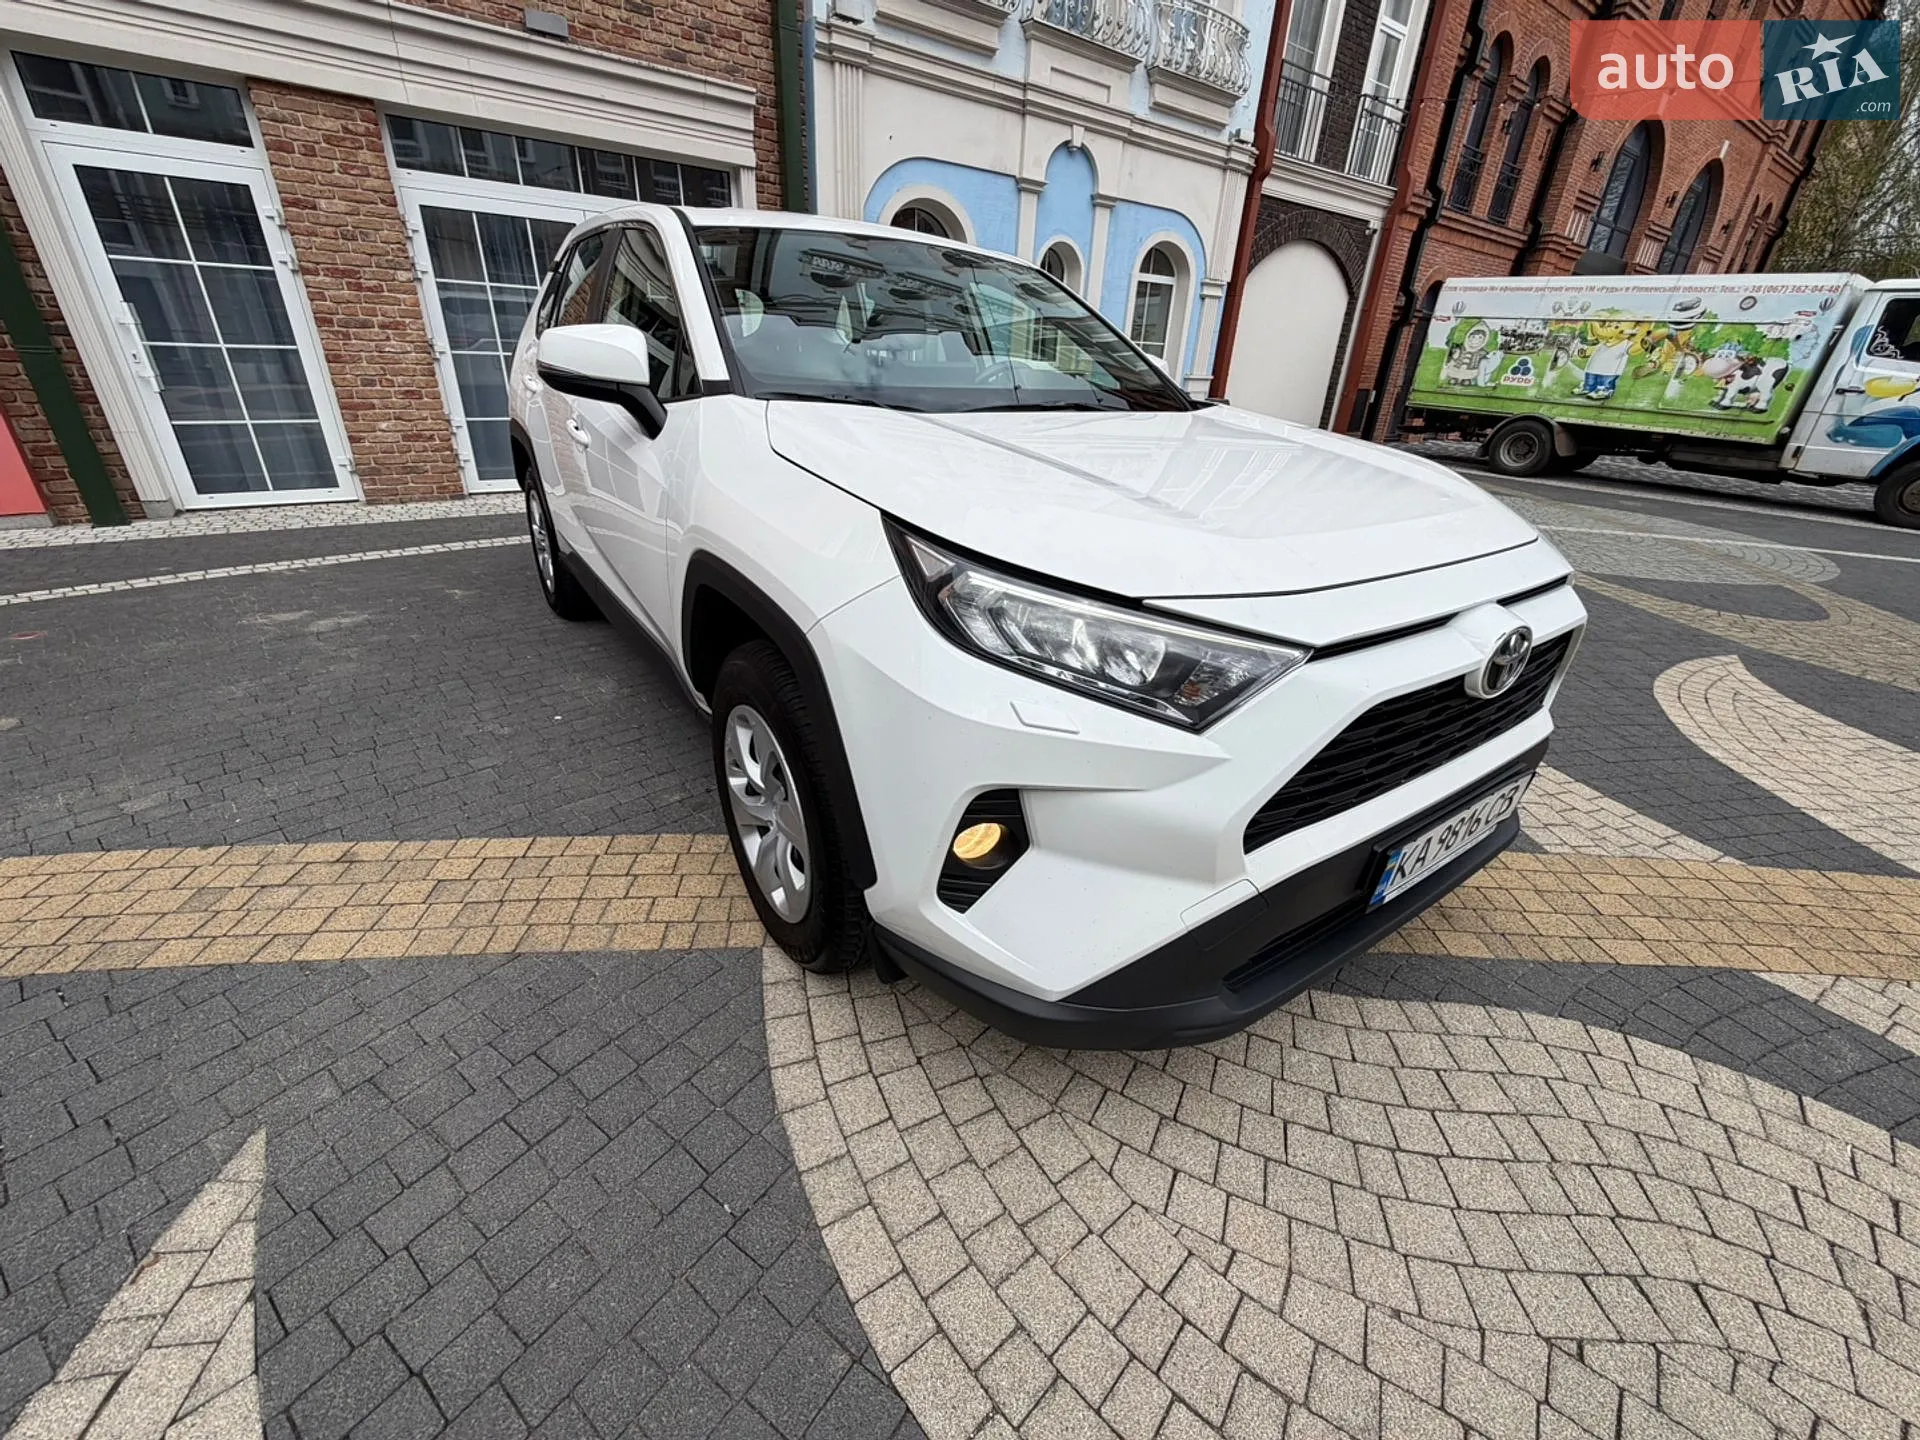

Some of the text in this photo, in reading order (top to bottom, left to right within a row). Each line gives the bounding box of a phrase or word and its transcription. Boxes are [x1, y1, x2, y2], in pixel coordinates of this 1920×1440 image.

[1390, 784, 1520, 886] KA 9816 CB
